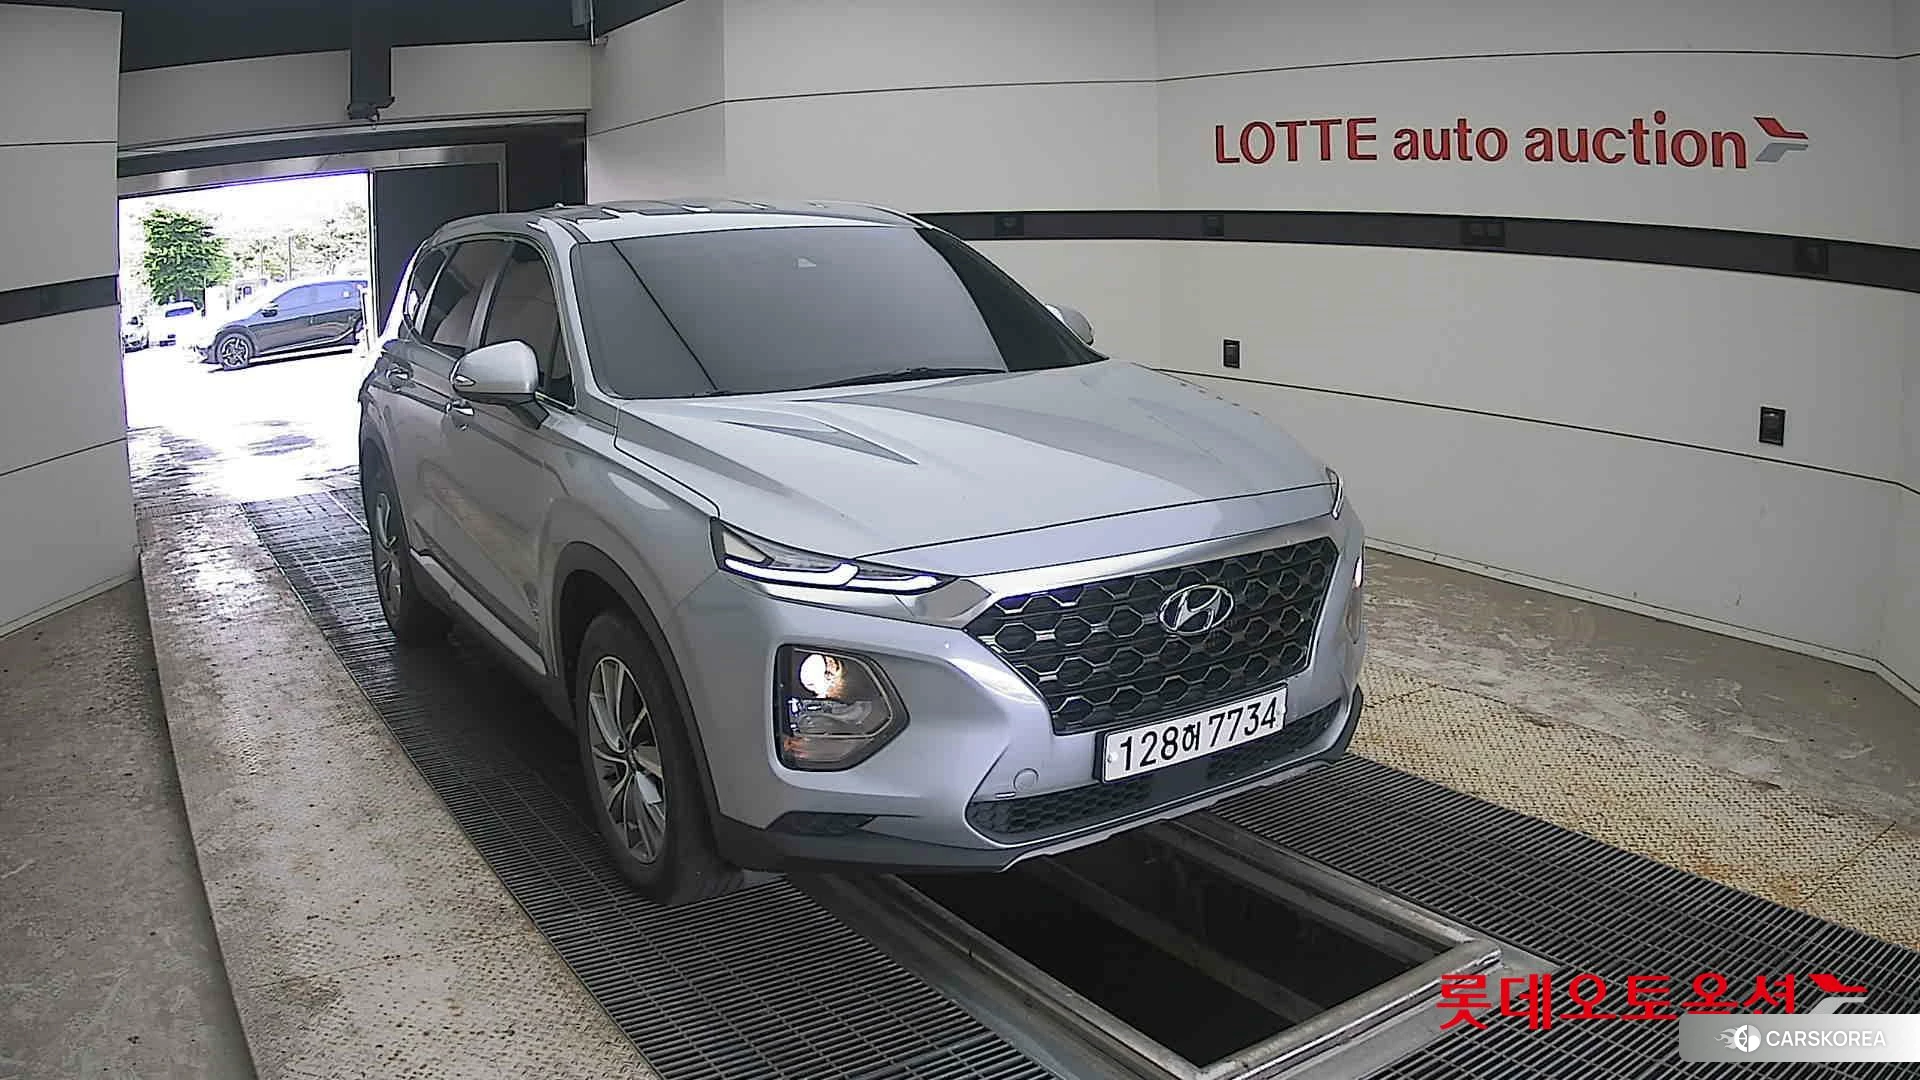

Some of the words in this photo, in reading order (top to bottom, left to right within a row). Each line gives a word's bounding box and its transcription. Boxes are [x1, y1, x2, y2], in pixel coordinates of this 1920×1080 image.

[1215, 117, 1377, 164] LOTTE
[1393, 119, 1508, 162] auto
[1524, 110, 1747, 170] auction
